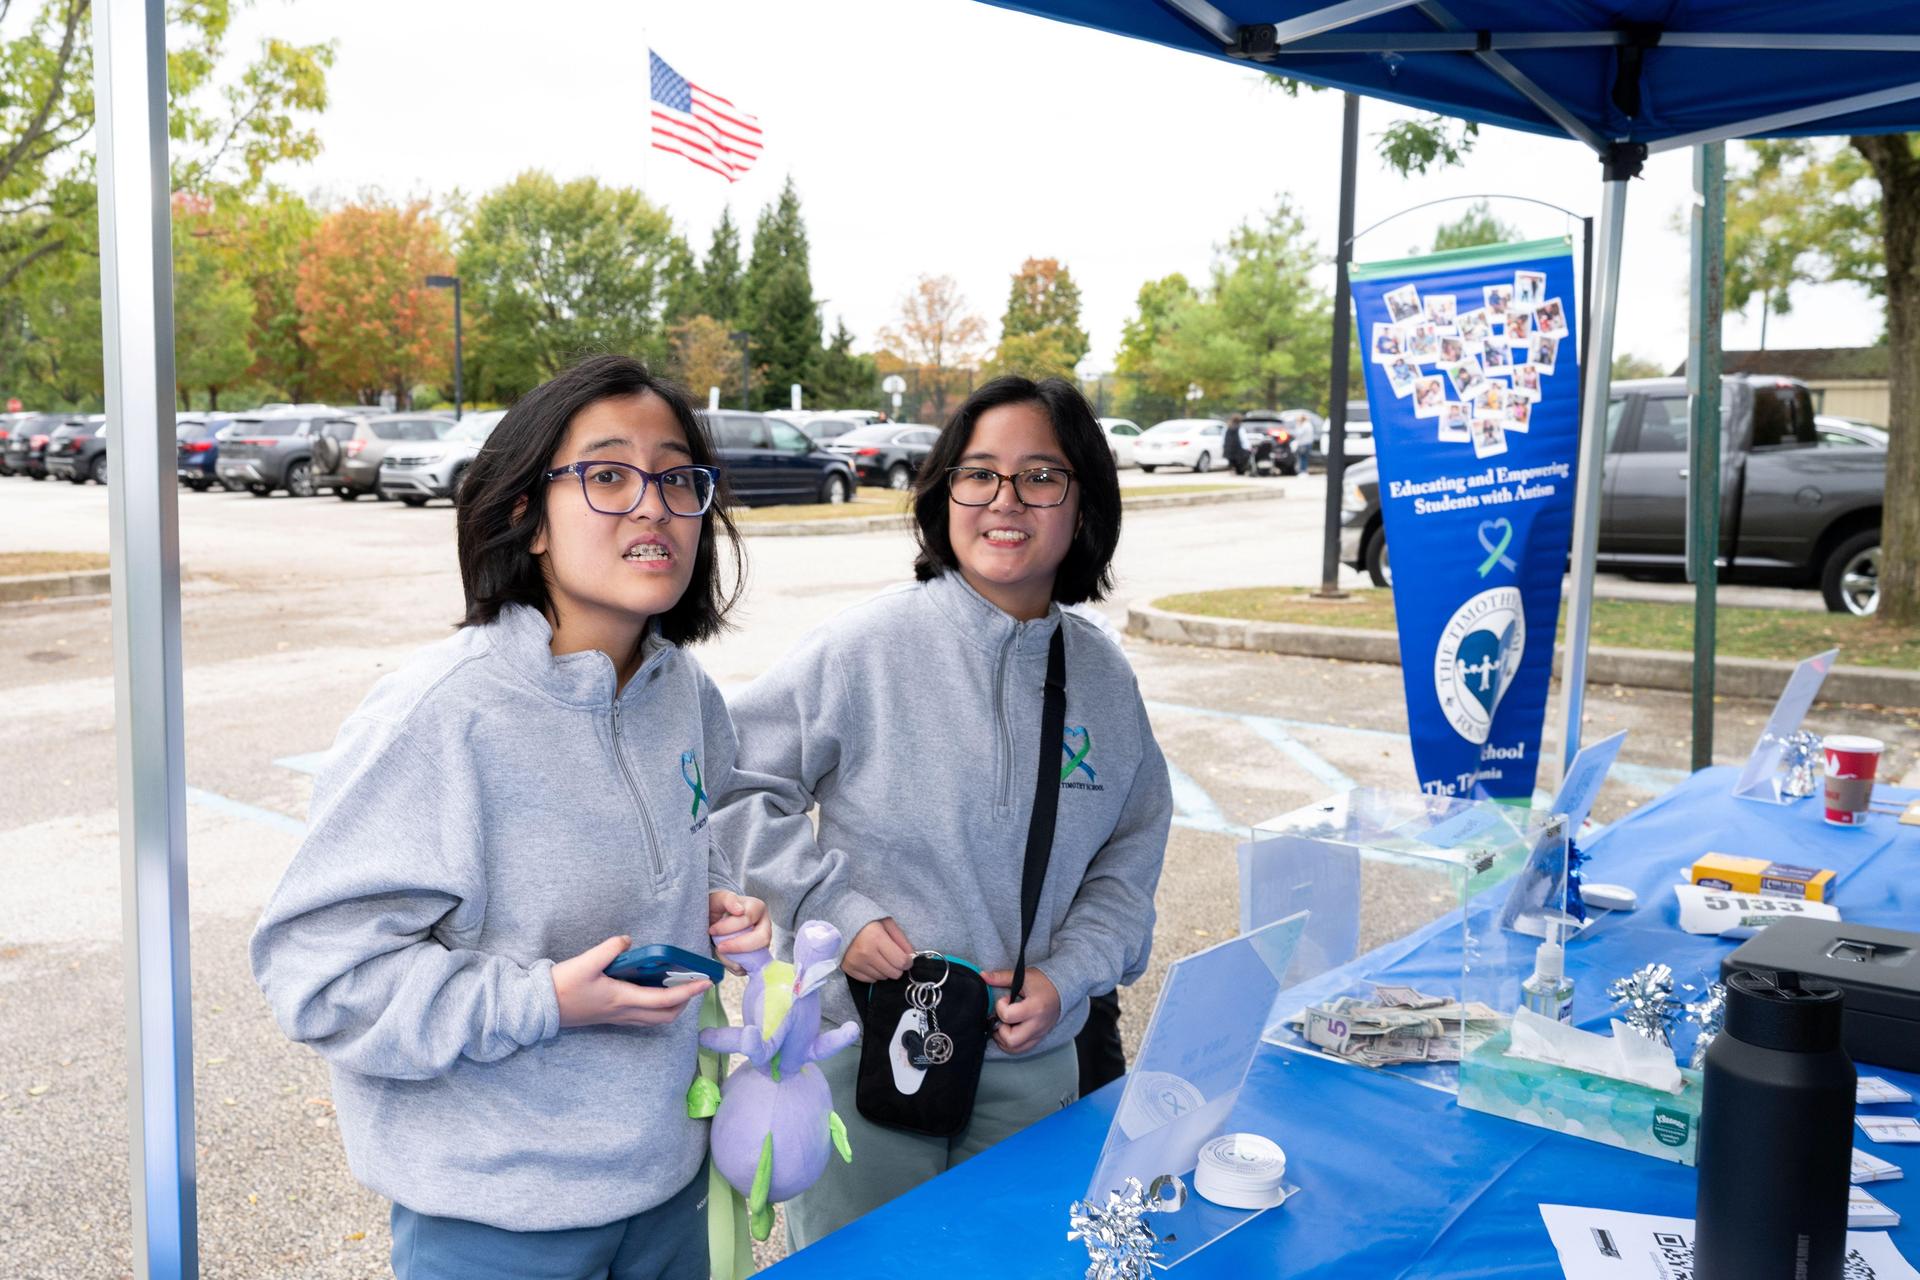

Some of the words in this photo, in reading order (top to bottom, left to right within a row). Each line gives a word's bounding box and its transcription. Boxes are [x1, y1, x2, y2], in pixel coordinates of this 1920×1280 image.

[1389, 476, 1466, 498] Educating
[1467, 468, 1494, 487] and
[1496, 461, 1570, 485] Empowering
[1414, 494, 1480, 515] Students
[1481, 486, 1512, 506] with
[1515, 484, 1555, 501] Autism
[1423, 779, 1456, 797] The
[1328, 1018, 1347, 1037] 5
